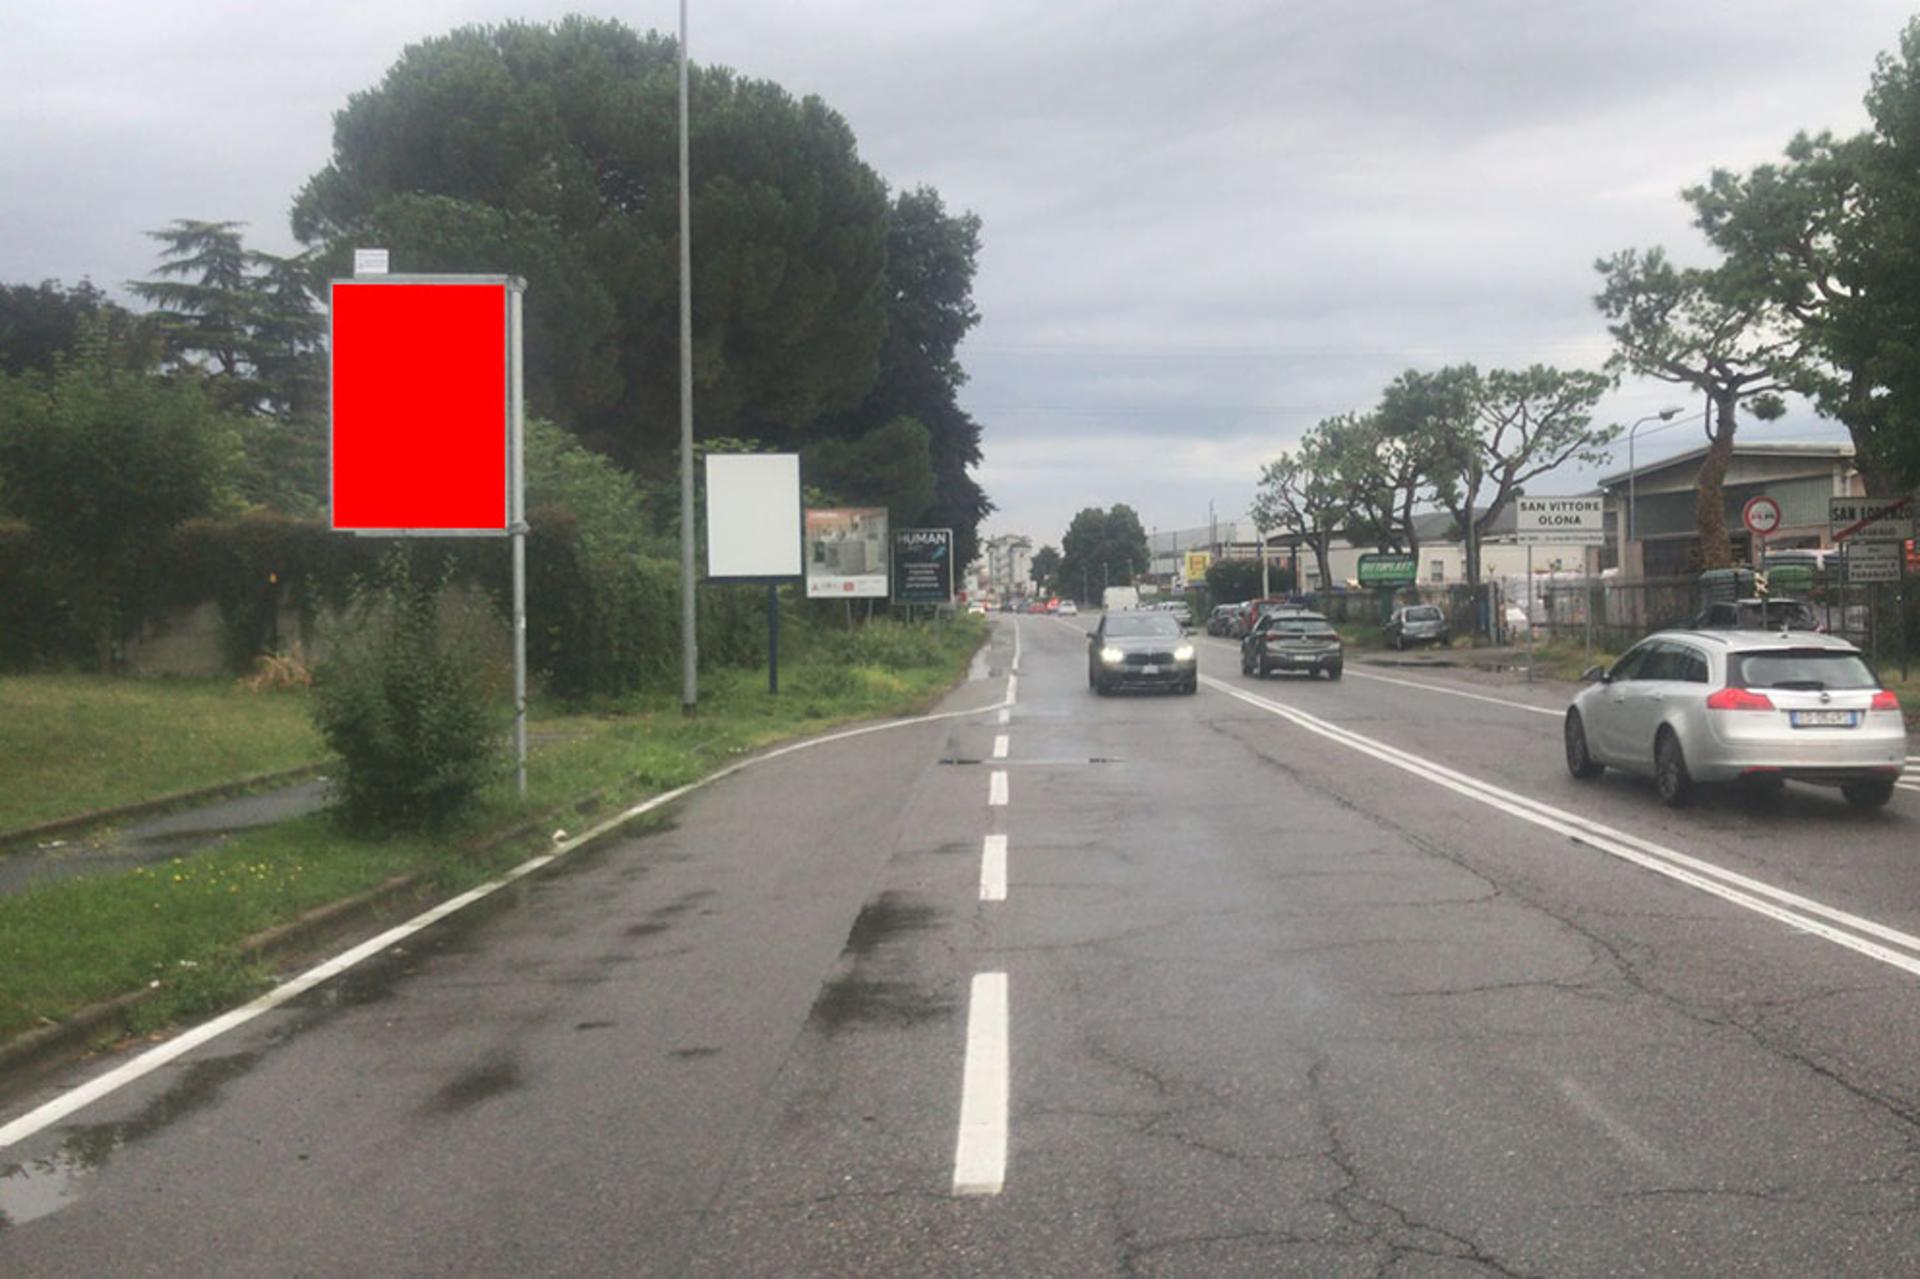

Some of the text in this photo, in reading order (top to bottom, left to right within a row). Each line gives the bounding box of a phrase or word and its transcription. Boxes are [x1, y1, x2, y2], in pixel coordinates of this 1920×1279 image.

[1520, 501, 1600, 512] SAN VITTORE
[1832, 507, 1856, 520] SAN
[1538, 515, 1581, 525] OLONA
[897, 533, 946, 545] HUMAN
